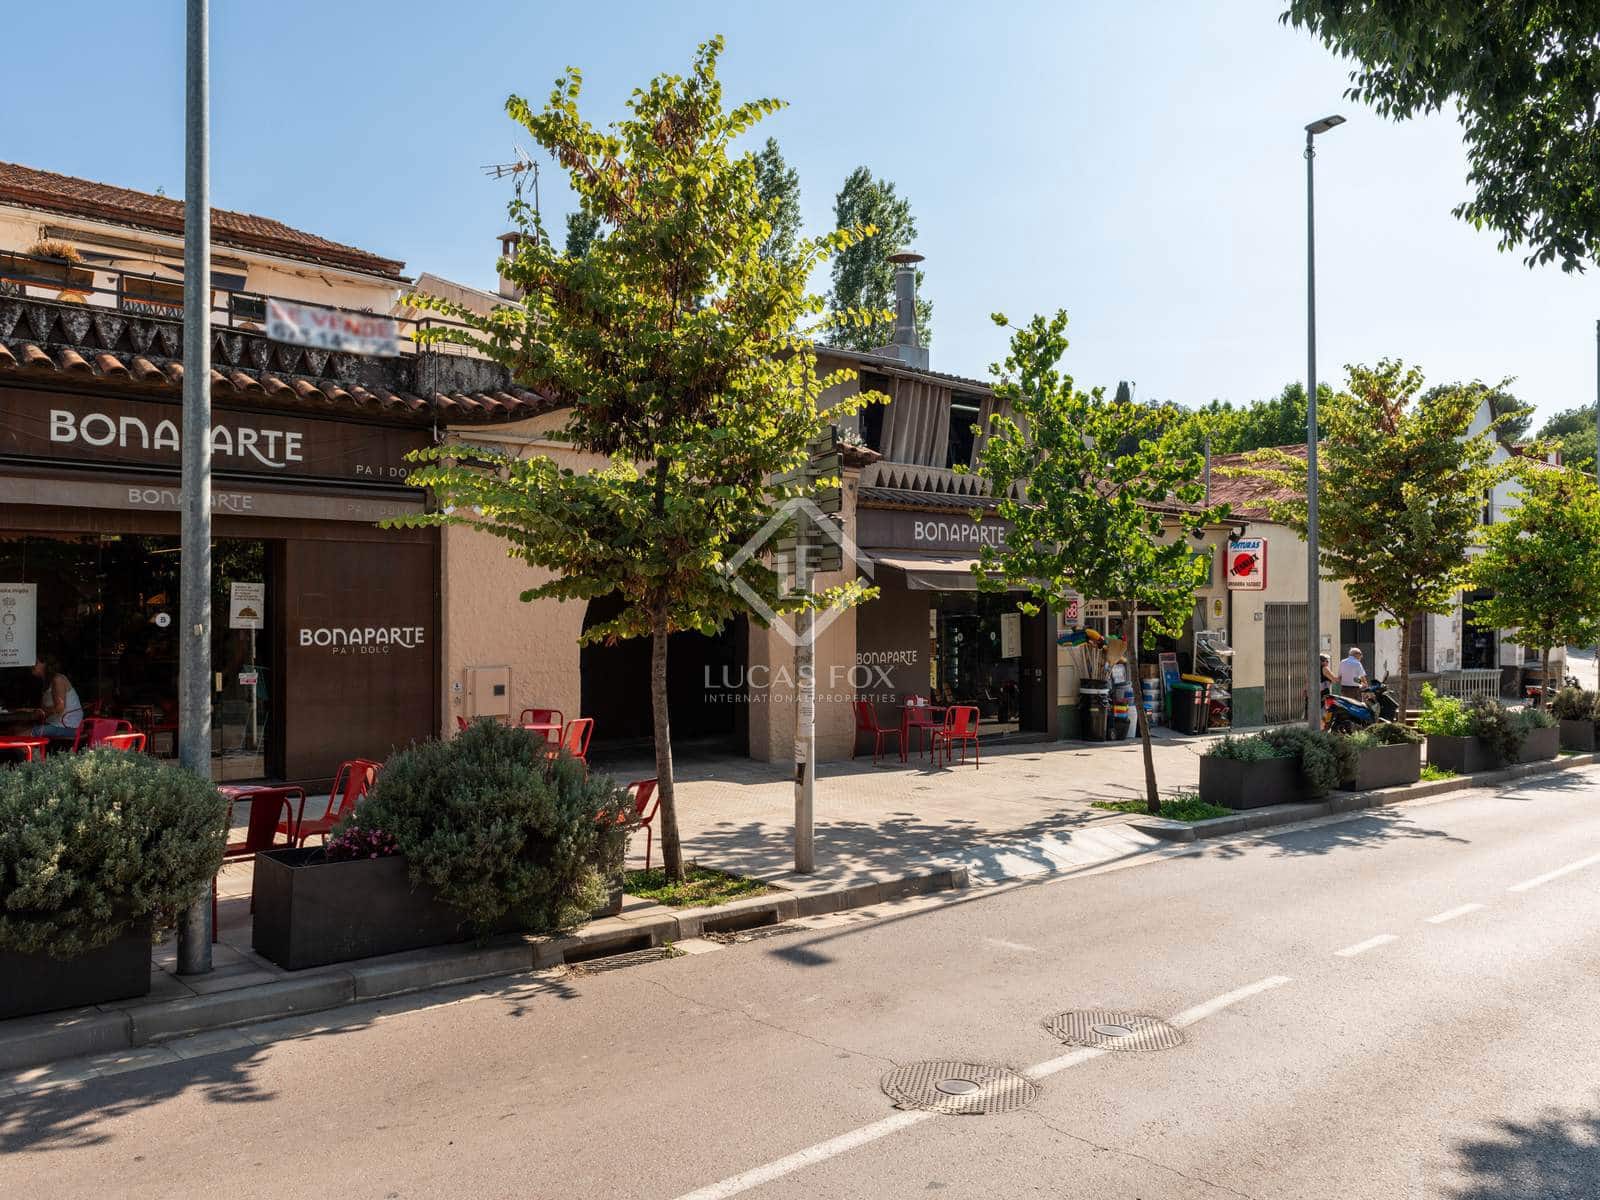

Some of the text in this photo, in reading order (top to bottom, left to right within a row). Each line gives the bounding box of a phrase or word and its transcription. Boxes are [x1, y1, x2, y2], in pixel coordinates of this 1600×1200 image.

[50, 409, 303, 468] BONAARTE
[356, 464, 373, 475] PA
[379, 467, 383, 476] I
[128, 488, 253, 512] BONRTE
[914, 521, 1005, 549] BONAPARTE
[300, 627, 425, 649] BONAPARTE
[332, 647, 347, 655] PA
[857, 650, 918, 666] BONAPARTE
